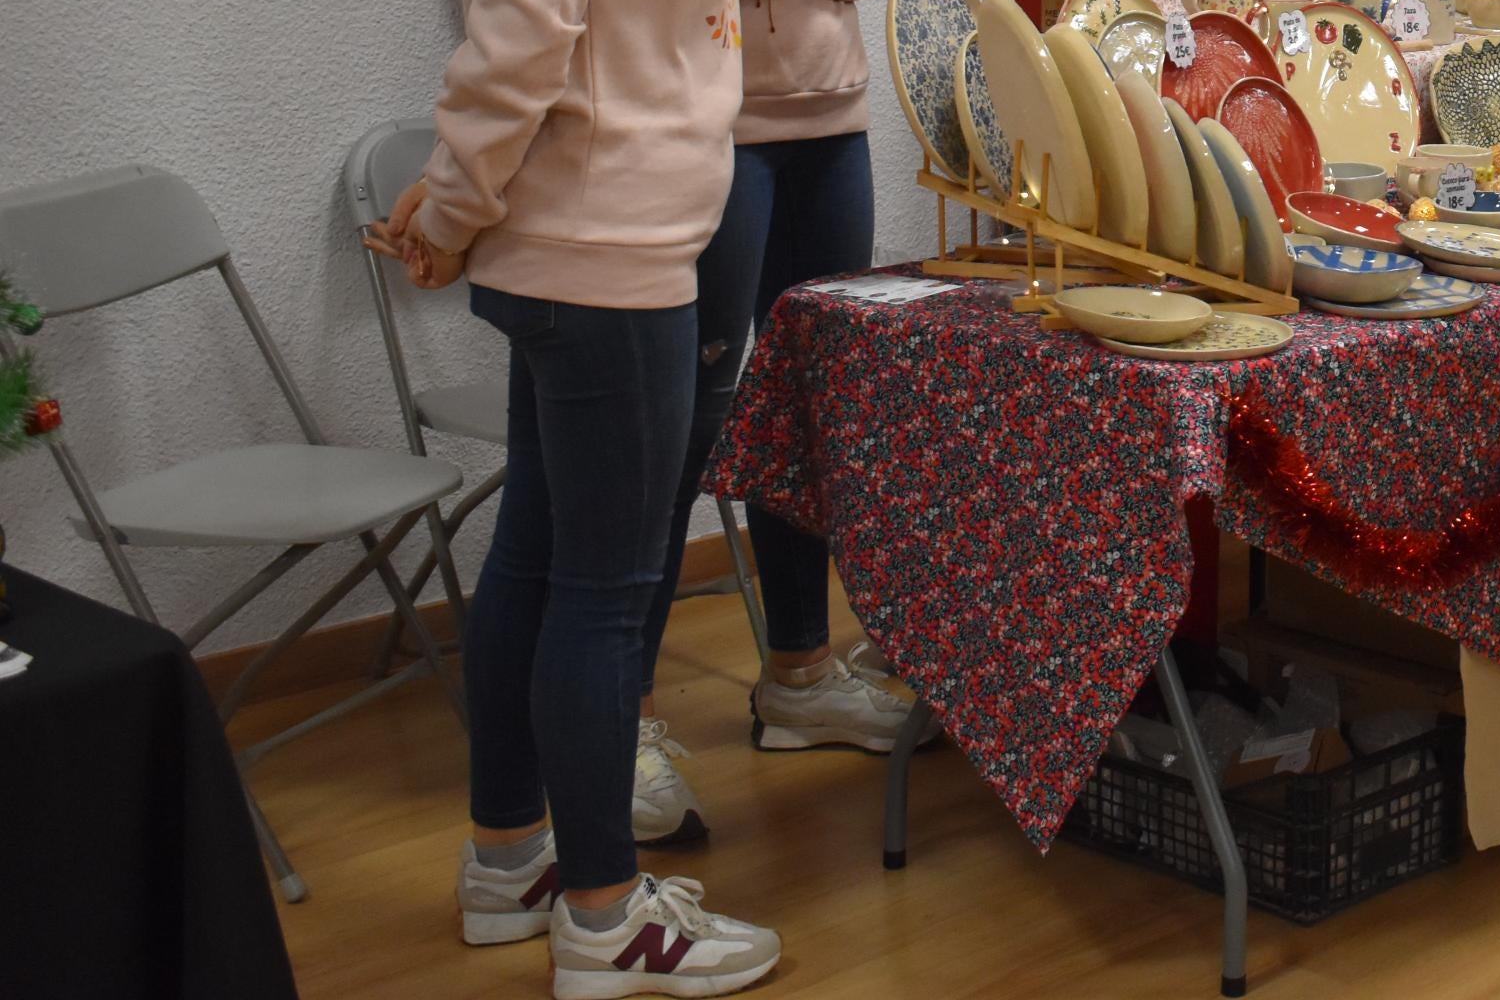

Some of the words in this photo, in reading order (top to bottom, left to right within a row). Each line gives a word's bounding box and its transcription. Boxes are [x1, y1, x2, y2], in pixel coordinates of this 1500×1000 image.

[1403, 22, 1420, 33] 18€
[1175, 45, 1191, 59] 25€
[1448, 196, 1465, 208] 18€
